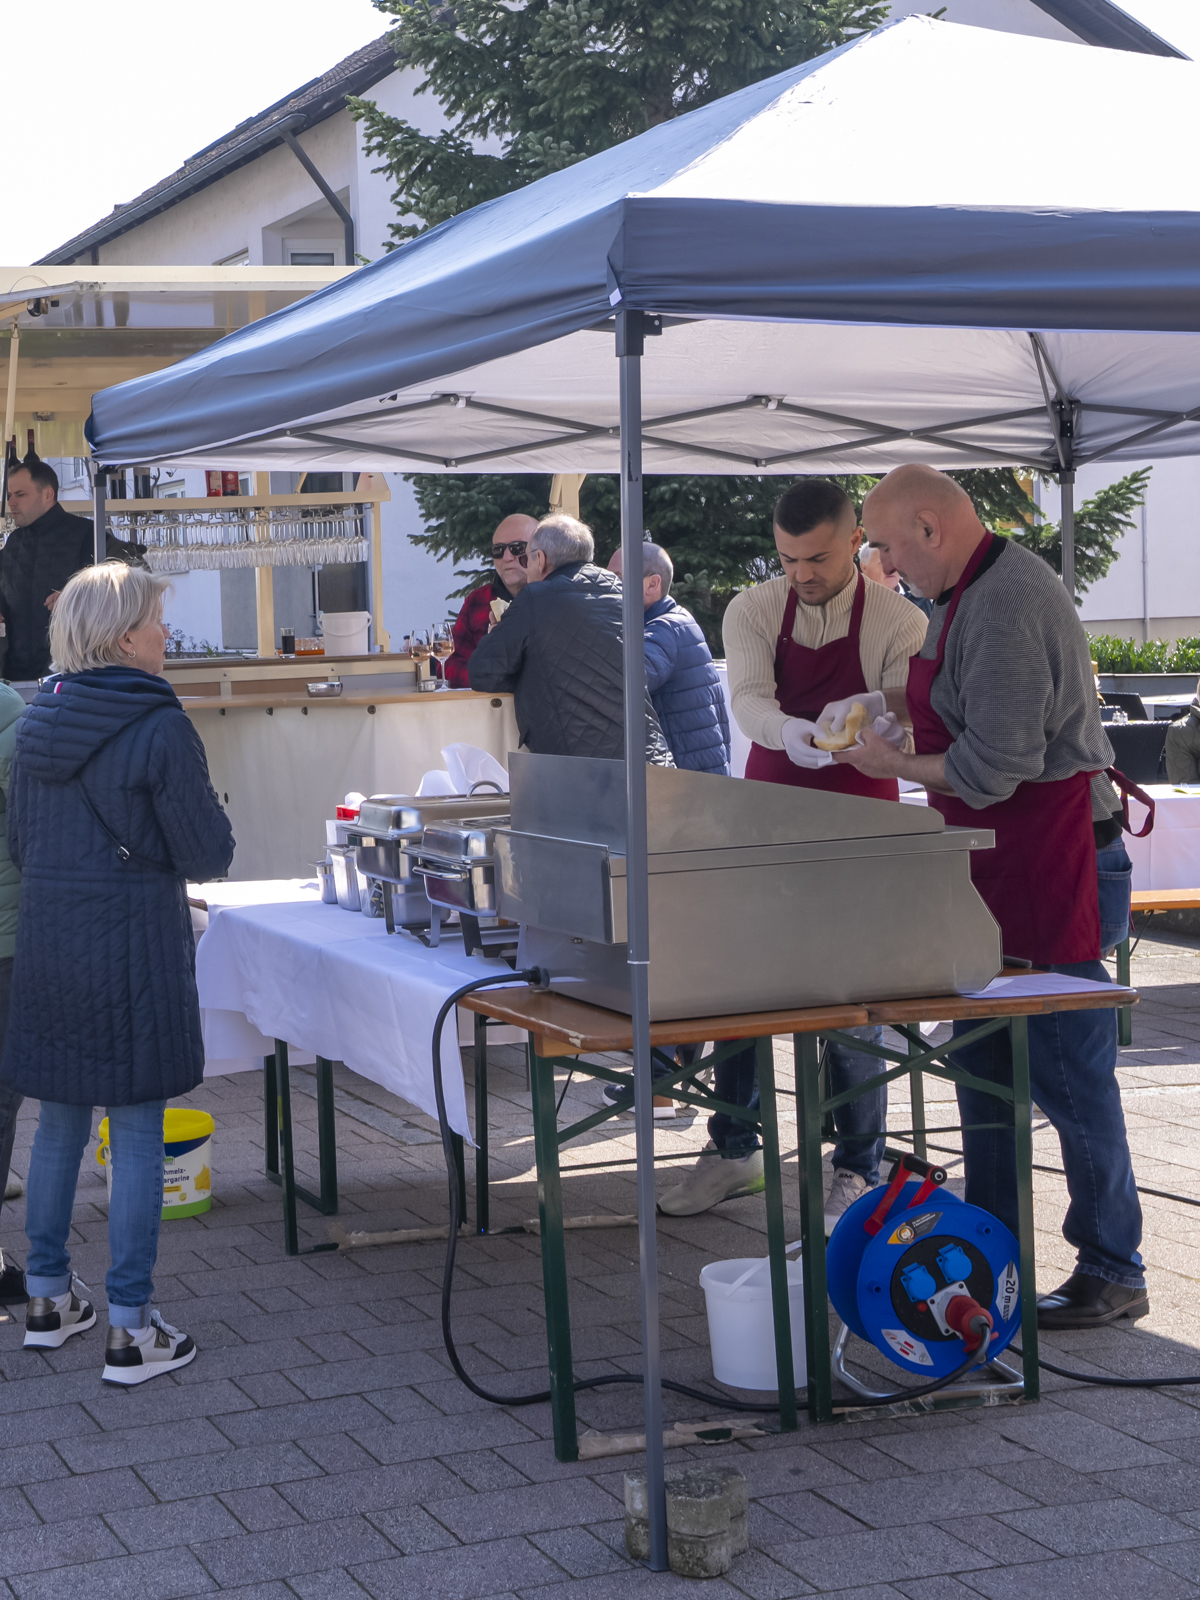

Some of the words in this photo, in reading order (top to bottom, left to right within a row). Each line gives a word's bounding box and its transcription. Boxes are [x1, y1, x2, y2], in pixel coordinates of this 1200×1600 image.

[164, 1175, 189, 1184] argarine
[1005, 1280, 1016, 1294] 20
[1004, 1295, 1011, 1304] m
